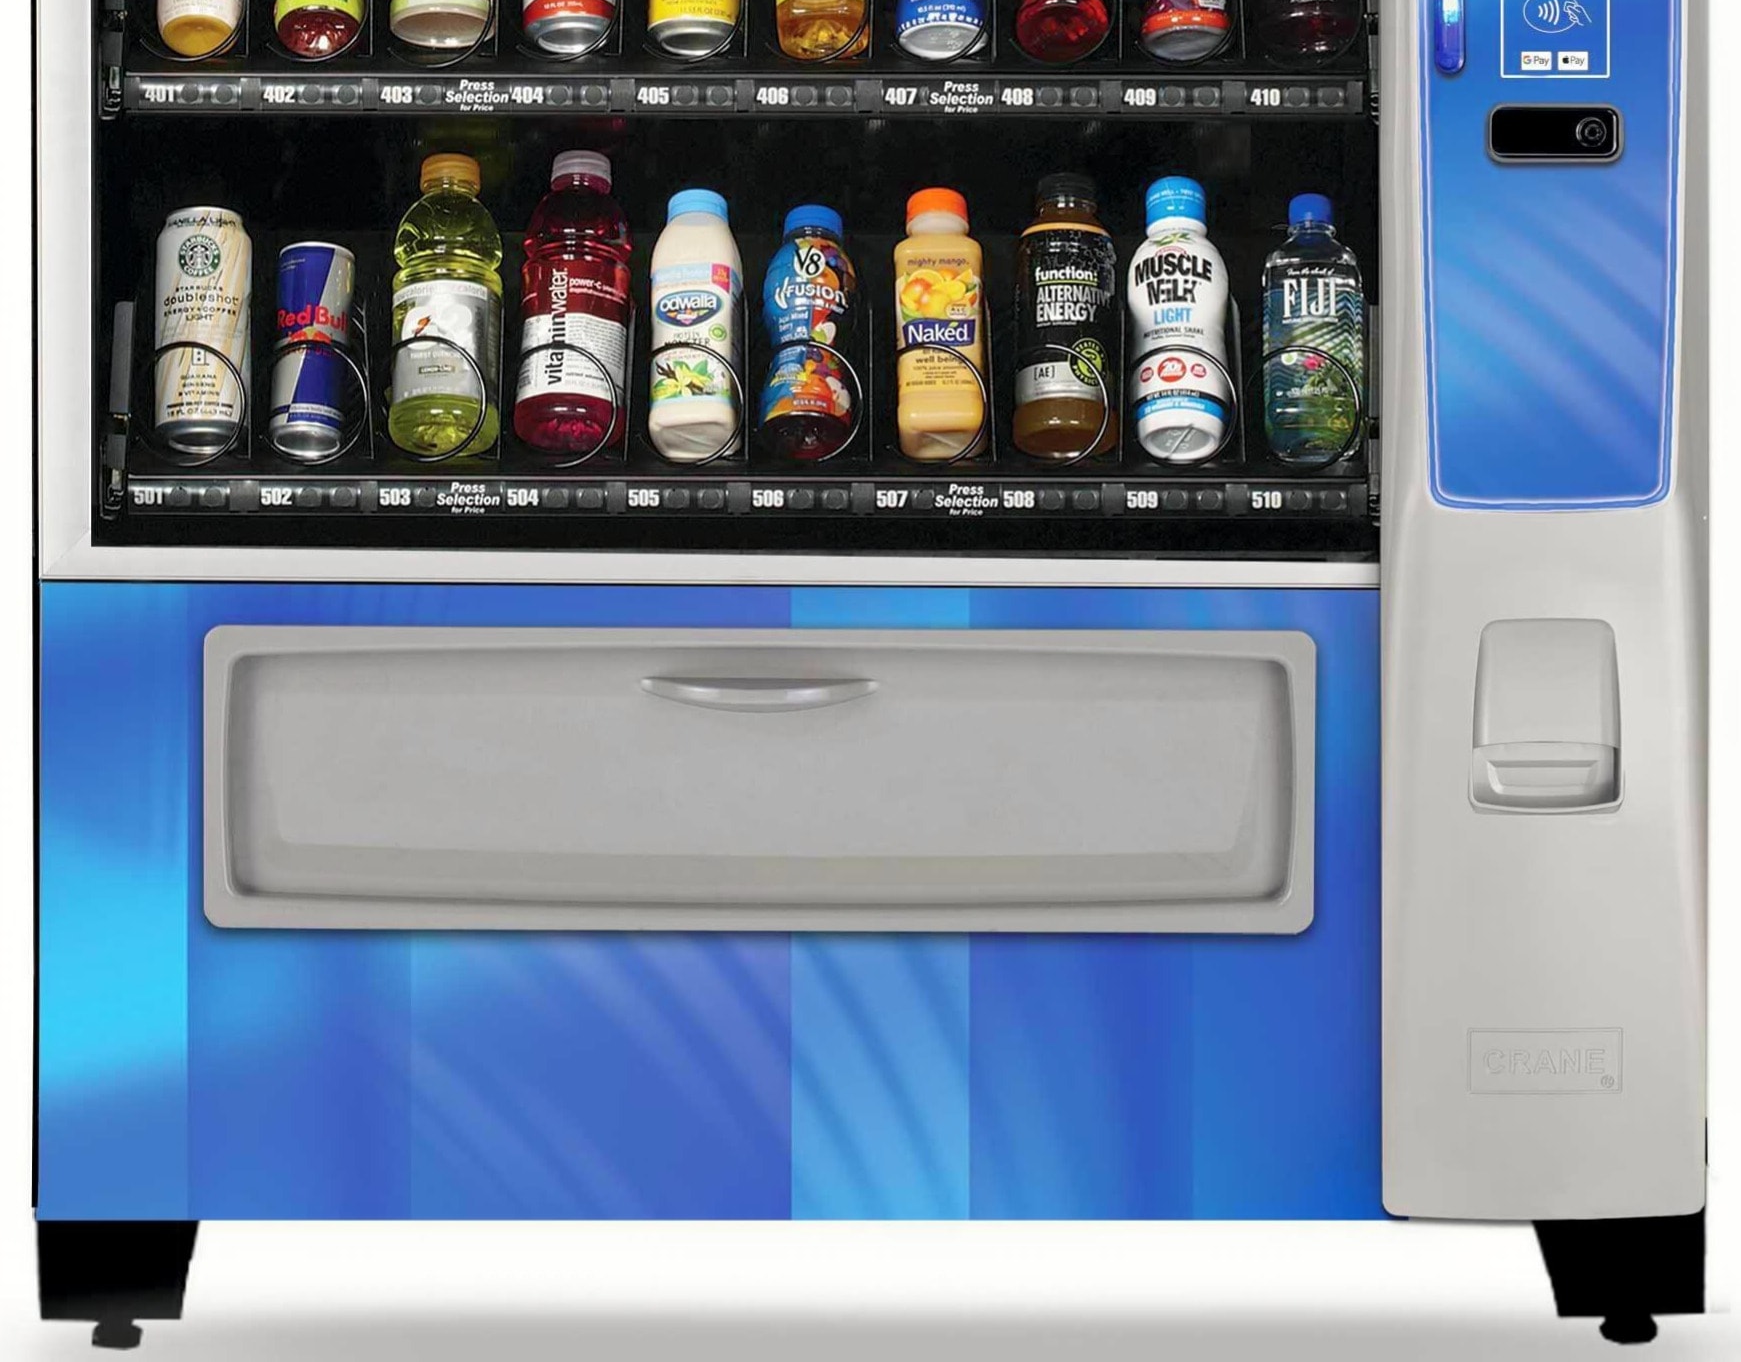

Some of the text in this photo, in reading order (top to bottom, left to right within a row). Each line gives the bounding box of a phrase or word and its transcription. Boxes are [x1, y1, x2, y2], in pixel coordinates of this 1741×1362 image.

[1533, 55, 1549, 67] Pay
[1570, 55, 1585, 67] Pay
[144, 85, 175, 103] 401
[263, 85, 296, 103] 402
[380, 85, 413, 104] 403
[511, 86, 544, 105] 404
[637, 86, 670, 105] 405
[756, 87, 789, 105] 406
[884, 87, 918, 105] 407
[1001, 87, 1034, 106] 408
[1124, 88, 1157, 106] 409
[1250, 88, 1281, 106] 410
[795, 245, 822, 276] V8
[907, 258, 966, 268] mighty mango
[1035, 266, 1098, 282] function:
[1134, 253, 1213, 287] MUSCLE
[163, 293, 239, 307] doubleshot
[660, 295, 717, 312] odwalla
[1283, 278, 1338, 318] FIJI
[277, 304, 348, 330] Red Bull
[1036, 303, 1097, 323] ENERGY
[1154, 307, 1193, 326] LIGHT
[908, 323, 968, 344] Naked
[134, 488, 163, 505] 501
[260, 486, 293, 505] 502
[379, 487, 411, 506] 503
[450, 481, 486, 494] Press
[436, 492, 501, 506] Selection
[507, 488, 539, 506] 504
[628, 488, 660, 507] 505
[752, 489, 784, 507] 506
[876, 489, 909, 508] 507
[1003, 490, 1035, 508] 508
[1126, 490, 1158, 509] 509
[1251, 491, 1282, 509] 510
[1483, 1049, 1606, 1075] CRANE
